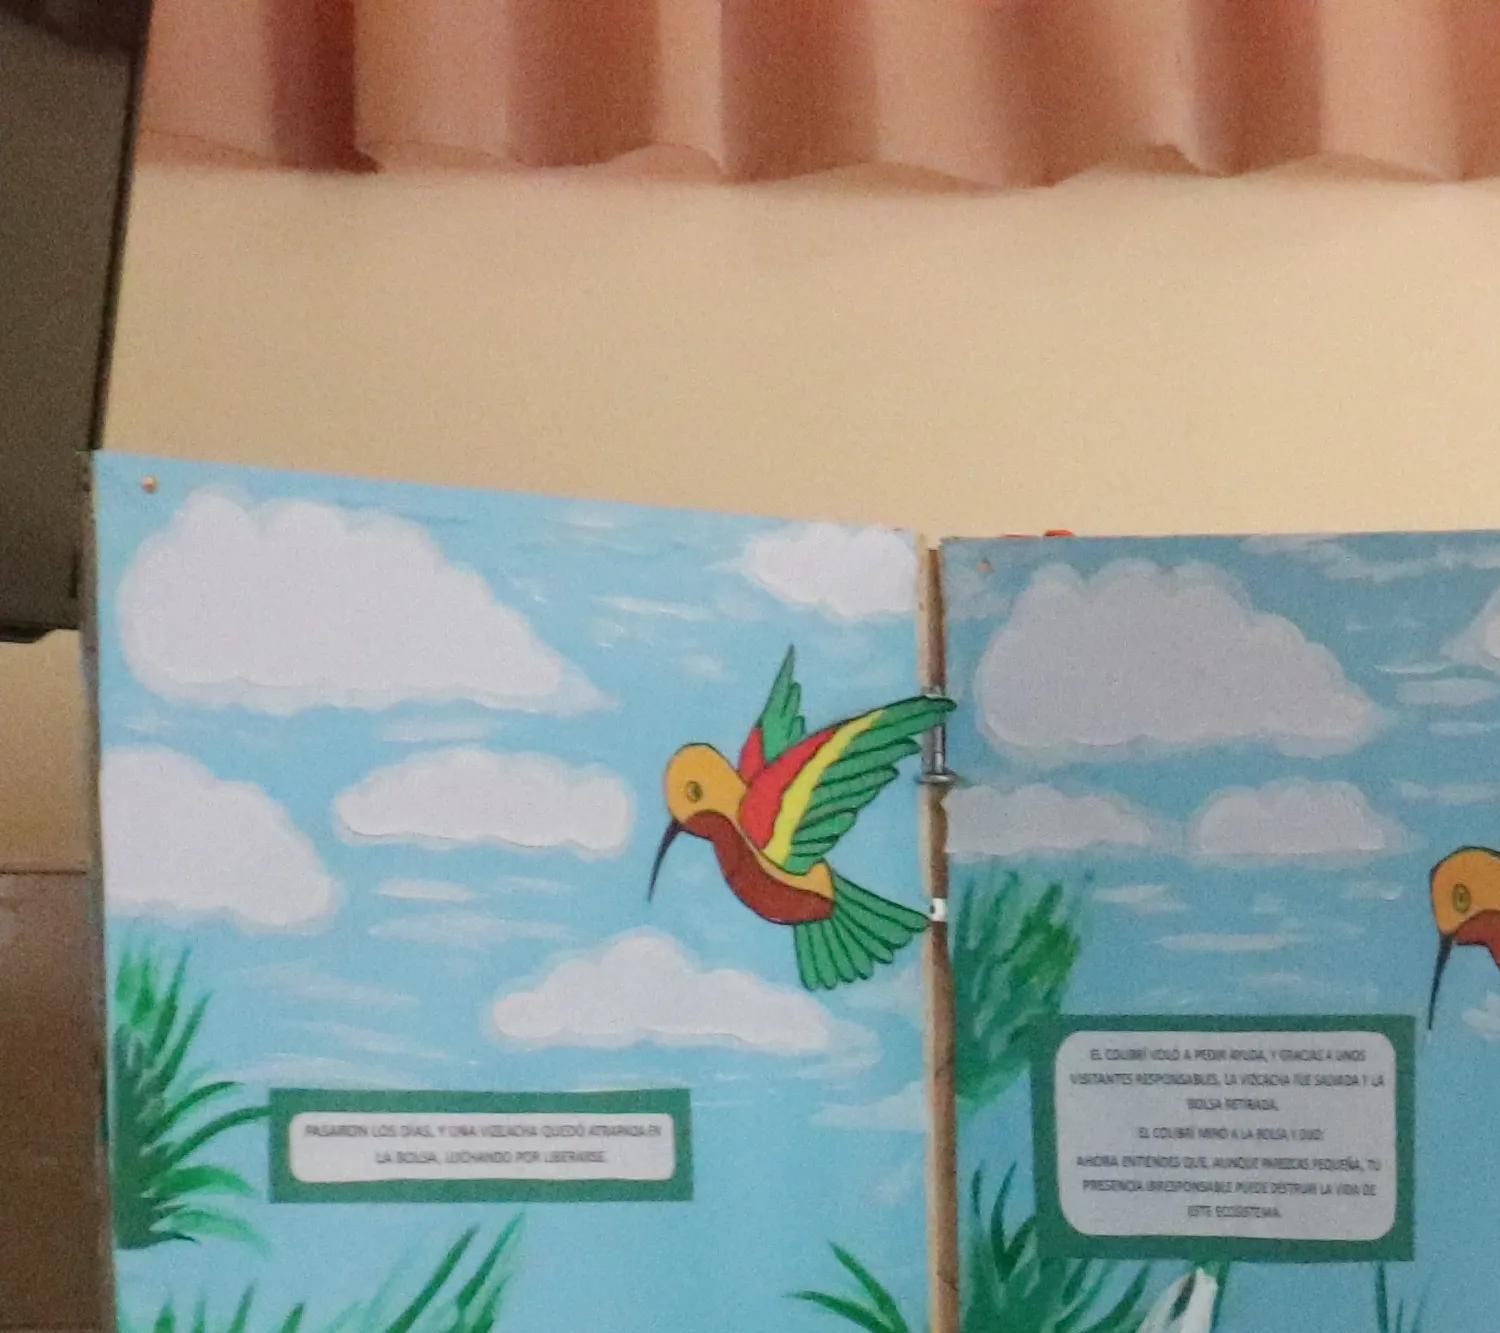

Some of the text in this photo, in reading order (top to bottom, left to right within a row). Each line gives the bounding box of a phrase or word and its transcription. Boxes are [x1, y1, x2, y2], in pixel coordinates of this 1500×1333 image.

[1090, 1048, 1102, 1061] EL
[1183, 1049, 1192, 1061] A
[1069, 1072, 1133, 1085] VISITANTES
[1224, 1073, 1237, 1086] LA
[1371, 1074, 1385, 1087] LA
[1186, 1097, 1222, 1111] BOLSA
[371, 1124, 398, 1138] LOS
[1138, 1126, 1150, 1139] EL
[1241, 1128, 1254, 1140] LA
[375, 1151, 392, 1164] LA
[515, 1150, 540, 1164] POR
[1076, 1155, 1119, 1168] AHORA
[1122, 1155, 1181, 1168] ENTIENDES
[1082, 1179, 1143, 1192] PRESENCIA
[1320, 1183, 1332, 1195] LA
[1187, 1204, 1212, 1218] ESTE
